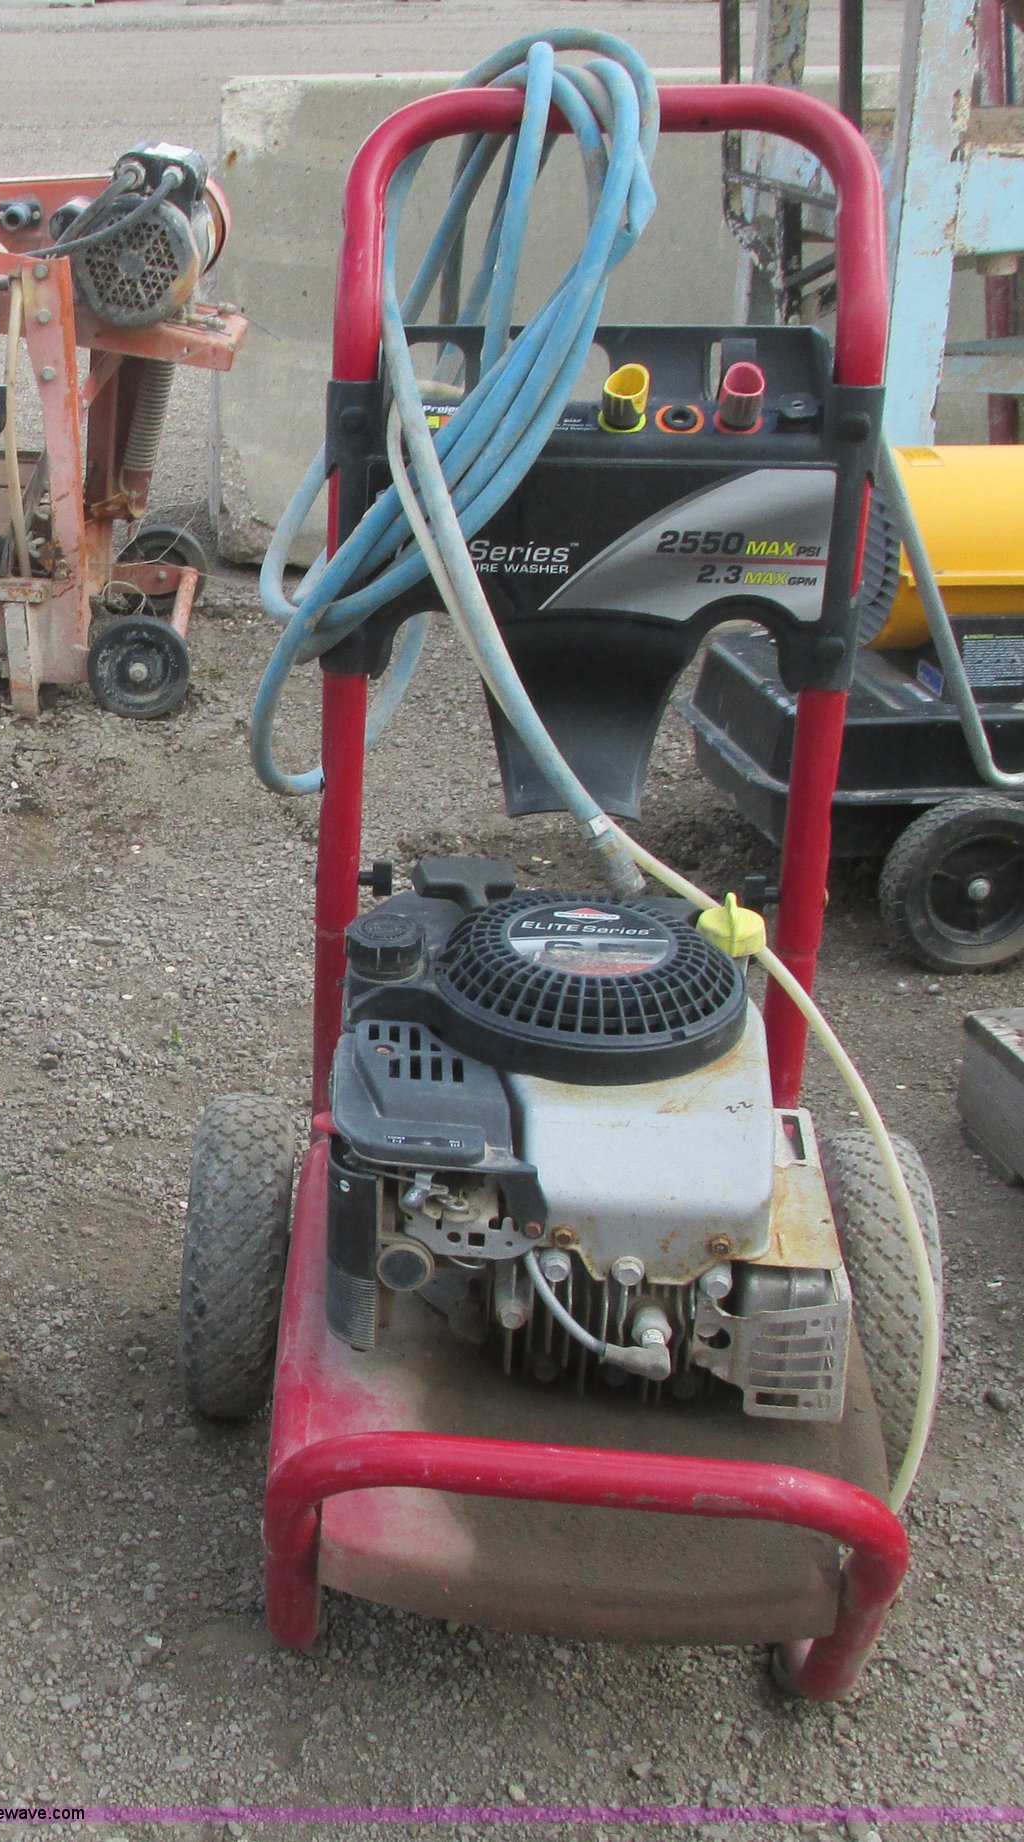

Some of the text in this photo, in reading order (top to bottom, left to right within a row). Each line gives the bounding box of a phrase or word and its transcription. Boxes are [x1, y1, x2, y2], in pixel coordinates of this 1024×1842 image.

[655, 530, 822, 558] 2550 MAX PSI
[504, 564, 569, 574] WASHER
[696, 564, 818, 587] 2.3 MAX GPM
[521, 921, 582, 932] ELITE
